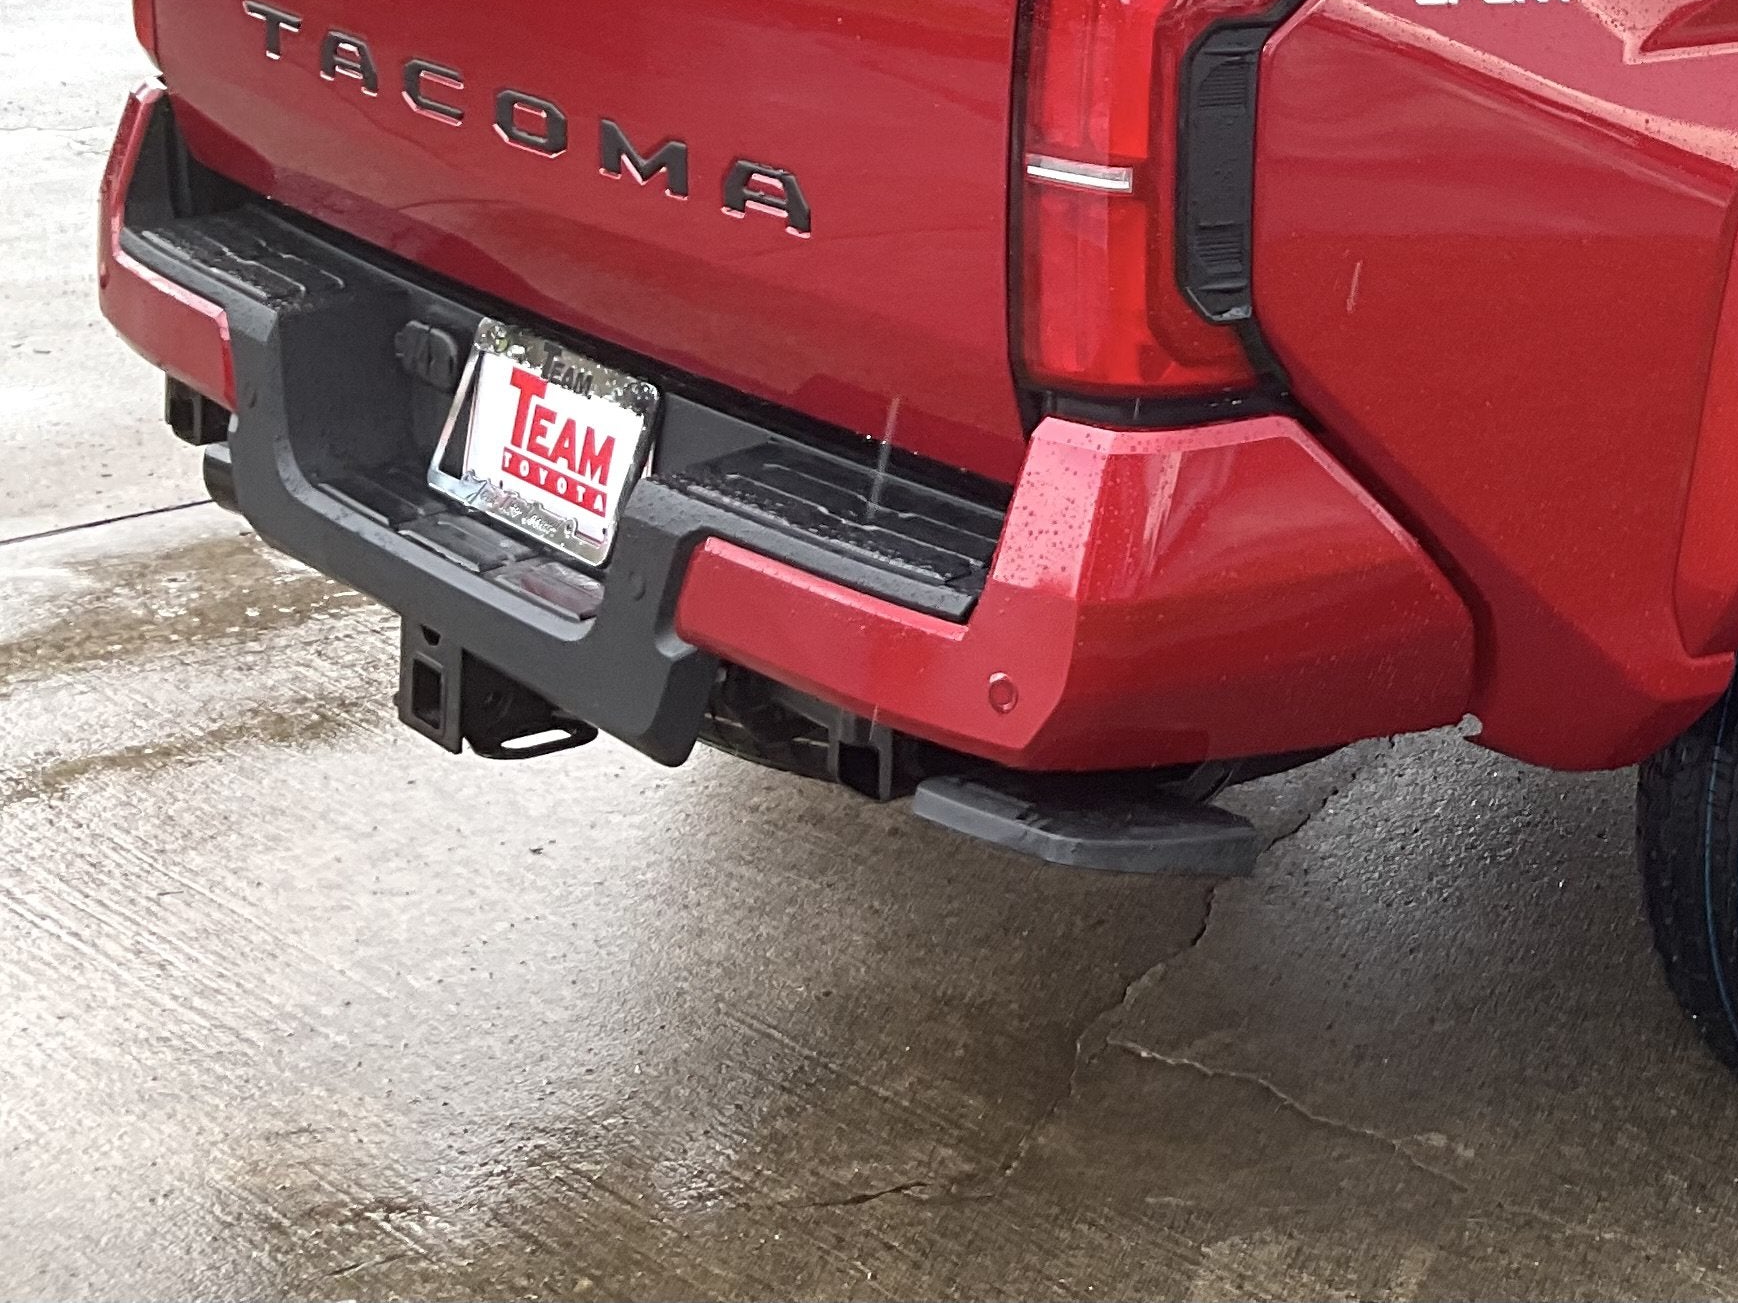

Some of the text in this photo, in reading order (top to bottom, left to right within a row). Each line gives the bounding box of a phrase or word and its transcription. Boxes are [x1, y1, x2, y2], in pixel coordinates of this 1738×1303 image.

[242, 0, 812, 239] TACOMA
[541, 341, 594, 396] TEAM
[509, 366, 616, 487] TEAM
[503, 452, 605, 512] TOYOTA
